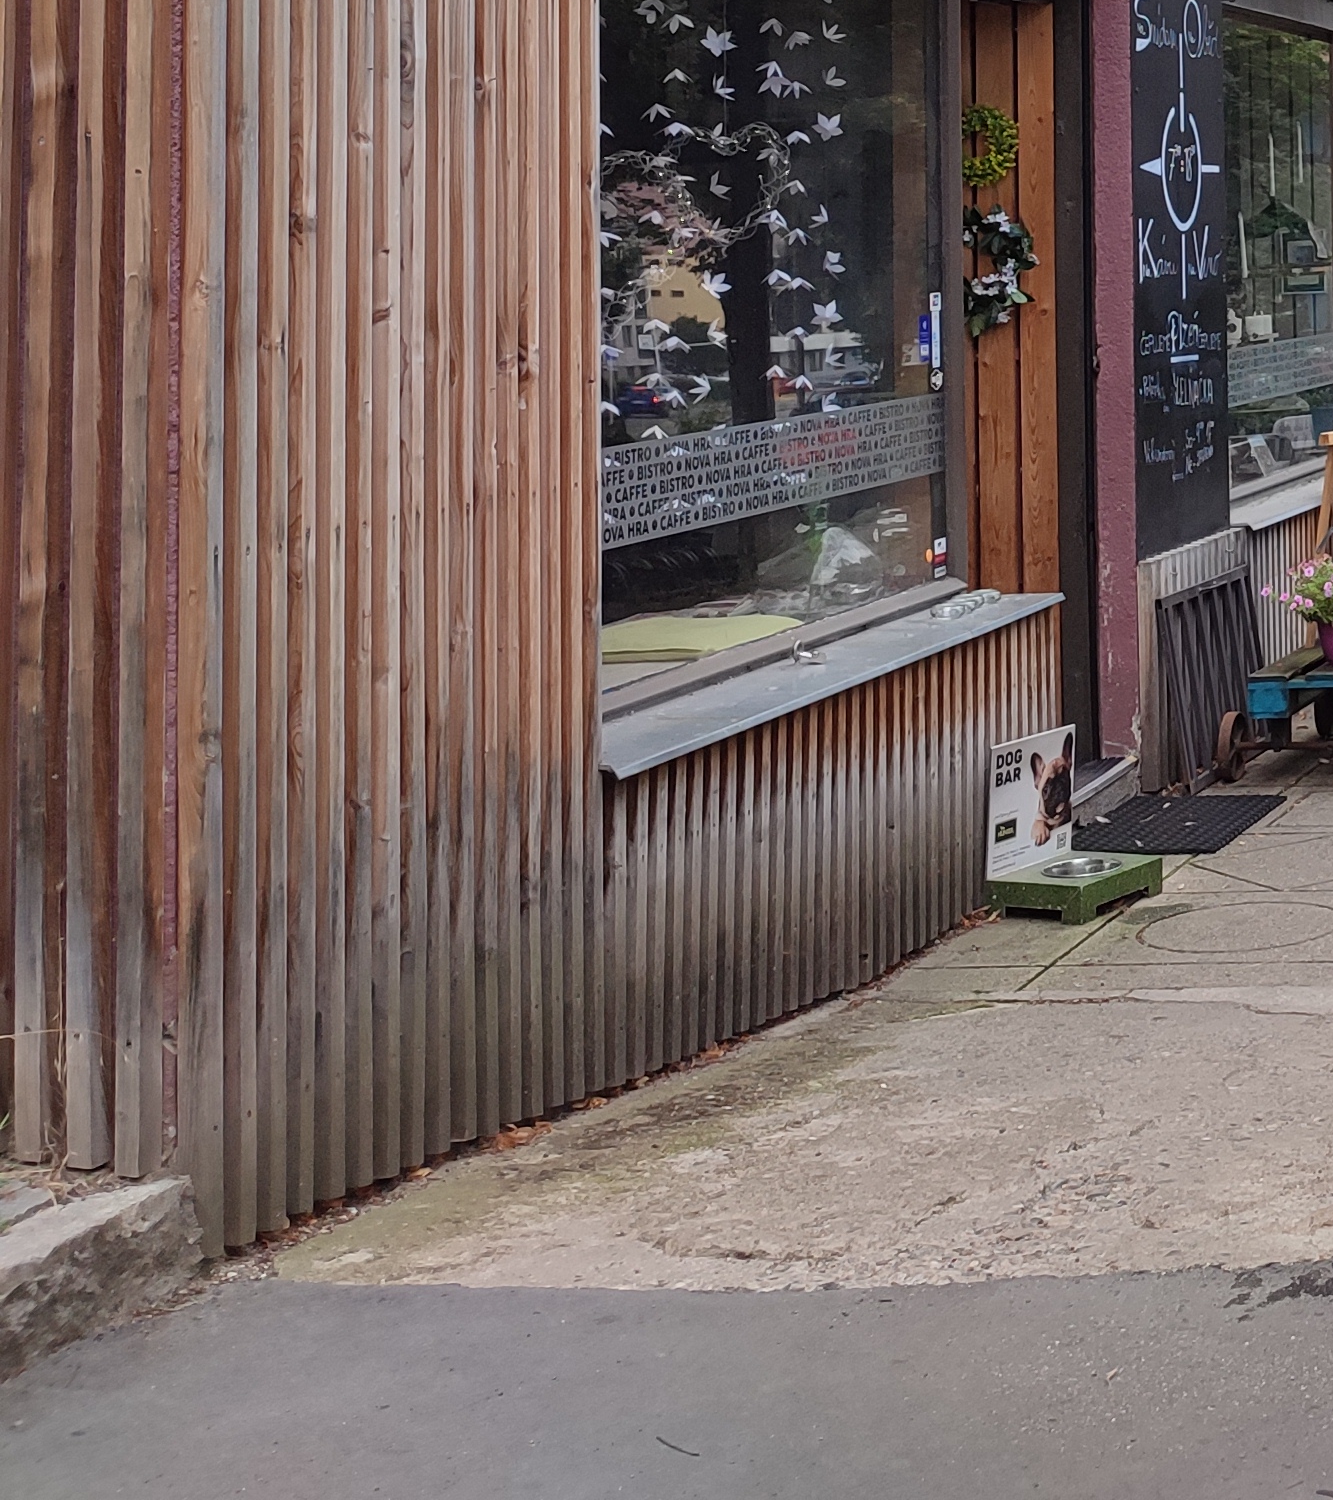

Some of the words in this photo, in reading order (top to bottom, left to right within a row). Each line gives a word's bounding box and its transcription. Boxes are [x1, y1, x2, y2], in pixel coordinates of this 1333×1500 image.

[614, 446, 651, 467] BISTRO
[800, 418, 822, 433] NOVA
[848, 409, 871, 425] CAFFE
[879, 404, 903, 420] BISTRO
[637, 461, 673, 480] BISTRO
[685, 455, 711, 472] NOVA
[714, 449, 732, 465] HRA
[742, 443, 769, 460] CAFFE
[865, 422, 887, 437] CAFFE
[615, 483, 647, 503] CAFFE
[660, 475, 694, 494] BISTRO
[706, 470, 731, 485] NOVA
[734, 464, 752, 479] HRA
[762, 457, 788, 473] CAFFE
[797, 450, 826, 467] BISTRO
[834, 445, 855, 459] NOVA
[880, 434, 901, 449] CAFFE
[638, 497, 669, 517] CAFFE
[726, 482, 750, 497] NOVA
[753, 478, 771, 492] HRA
[851, 456, 871, 471] NOVA
[895, 446, 916, 462] CAFFE
[603, 526, 624, 543] OVA
[628, 521, 649, 538] HRA
[660, 511, 691, 531] CAFFE
[702, 501, 735, 521] BISTRO
[746, 495, 769, 511] NOVA
[772, 489, 789, 504] HRA
[832, 473, 859, 491] BISTRO
[867, 468, 887, 482] NOVA
[995, 749, 1023, 770] DOG
[995, 767, 1021, 788] BAR
